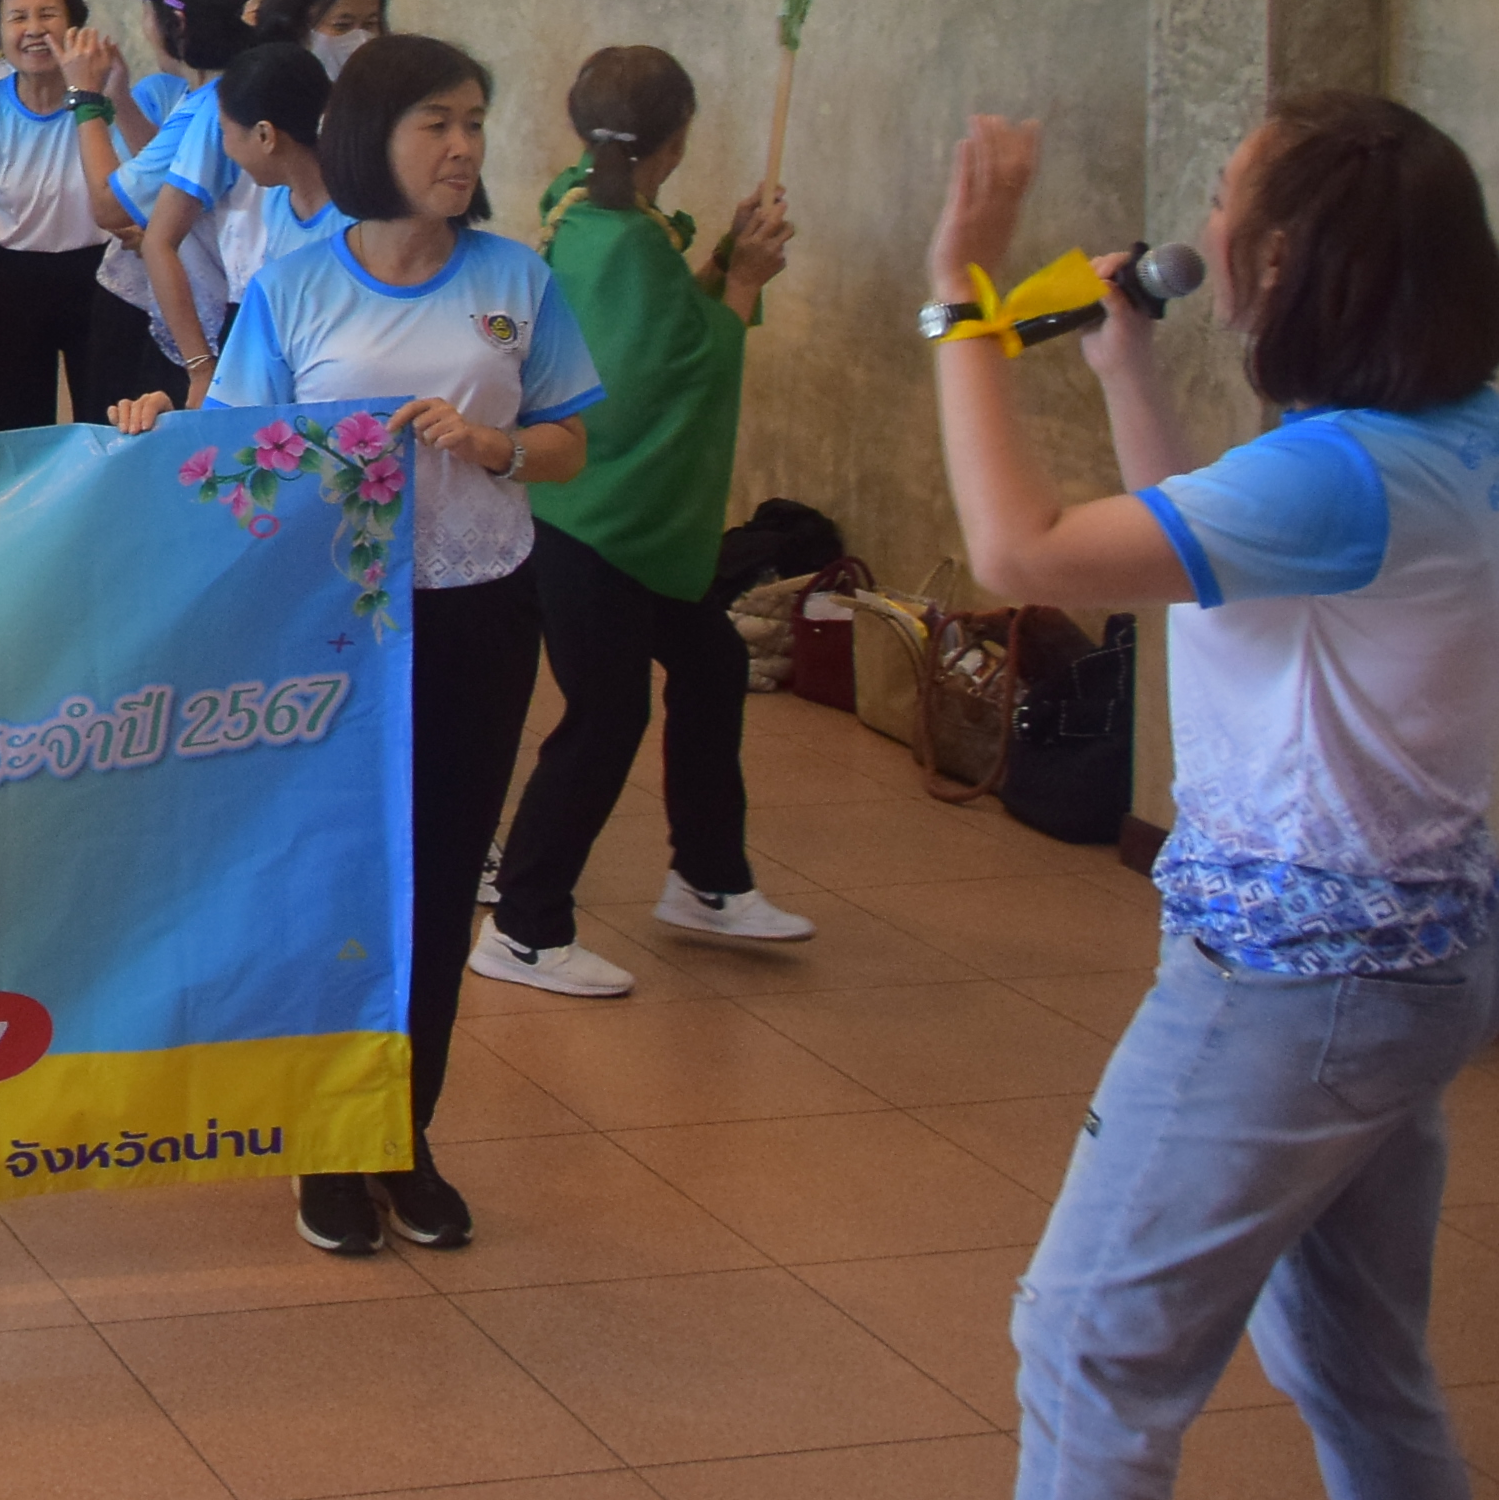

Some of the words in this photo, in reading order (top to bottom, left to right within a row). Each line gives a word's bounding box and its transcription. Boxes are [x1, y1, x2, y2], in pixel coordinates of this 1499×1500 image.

[180, 678, 343, 749] 2567
[4, 1118, 283, 1179] จังหวัดน่าน
